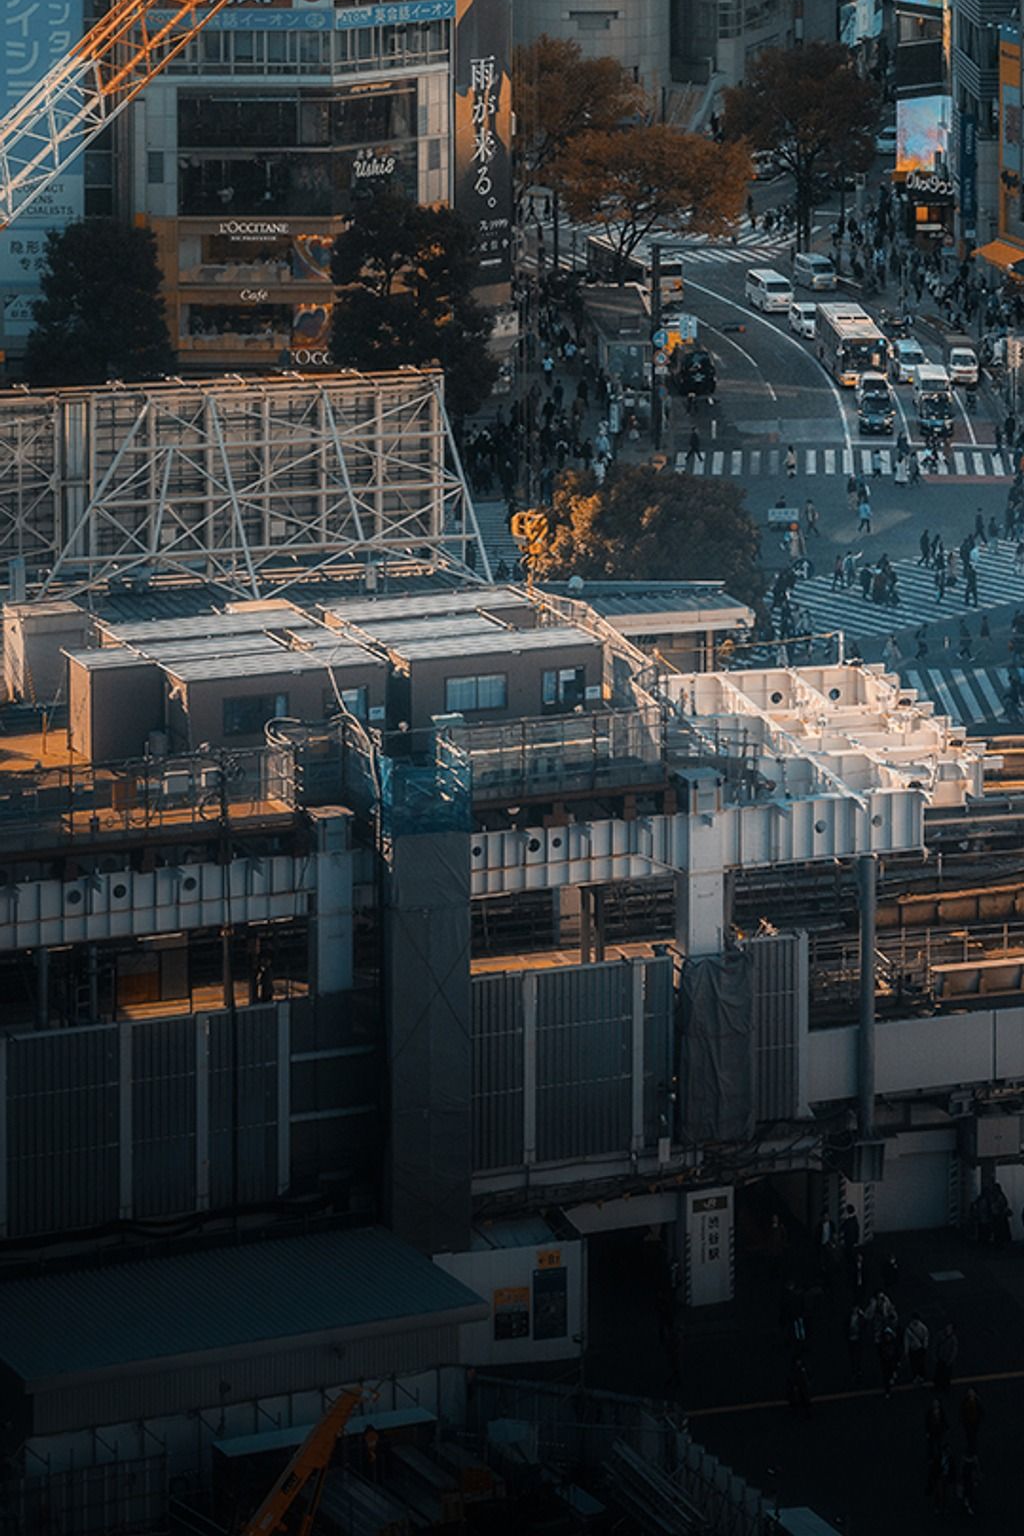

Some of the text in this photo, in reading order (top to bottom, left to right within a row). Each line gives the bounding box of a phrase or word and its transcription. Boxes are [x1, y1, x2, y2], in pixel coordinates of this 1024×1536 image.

[470, 55, 499, 210] 雨が来る。
[219, 220, 290, 234] L'OCCITANE
